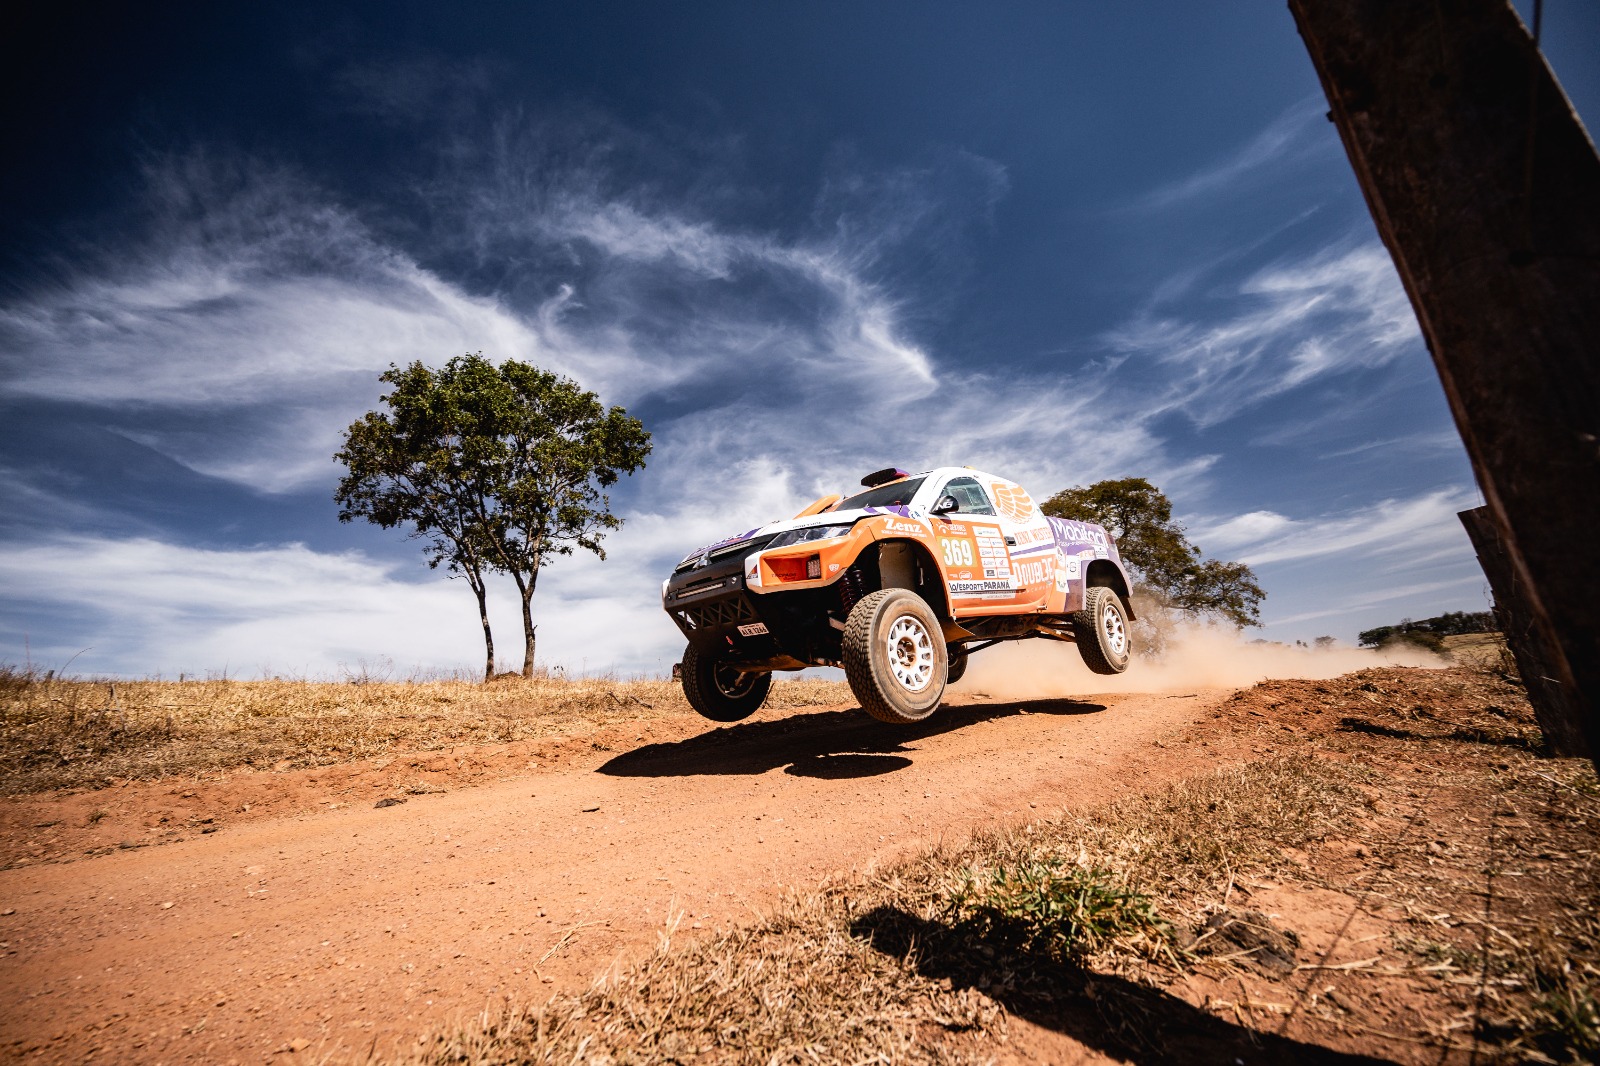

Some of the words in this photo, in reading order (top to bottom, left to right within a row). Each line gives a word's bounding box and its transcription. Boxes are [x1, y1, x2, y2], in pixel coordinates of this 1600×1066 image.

[883, 517, 922, 533] Zenz
[941, 538, 973, 566] 369
[959, 583, 983, 591] ESPORTE
[983, 580, 1010, 590] PARANÁ
